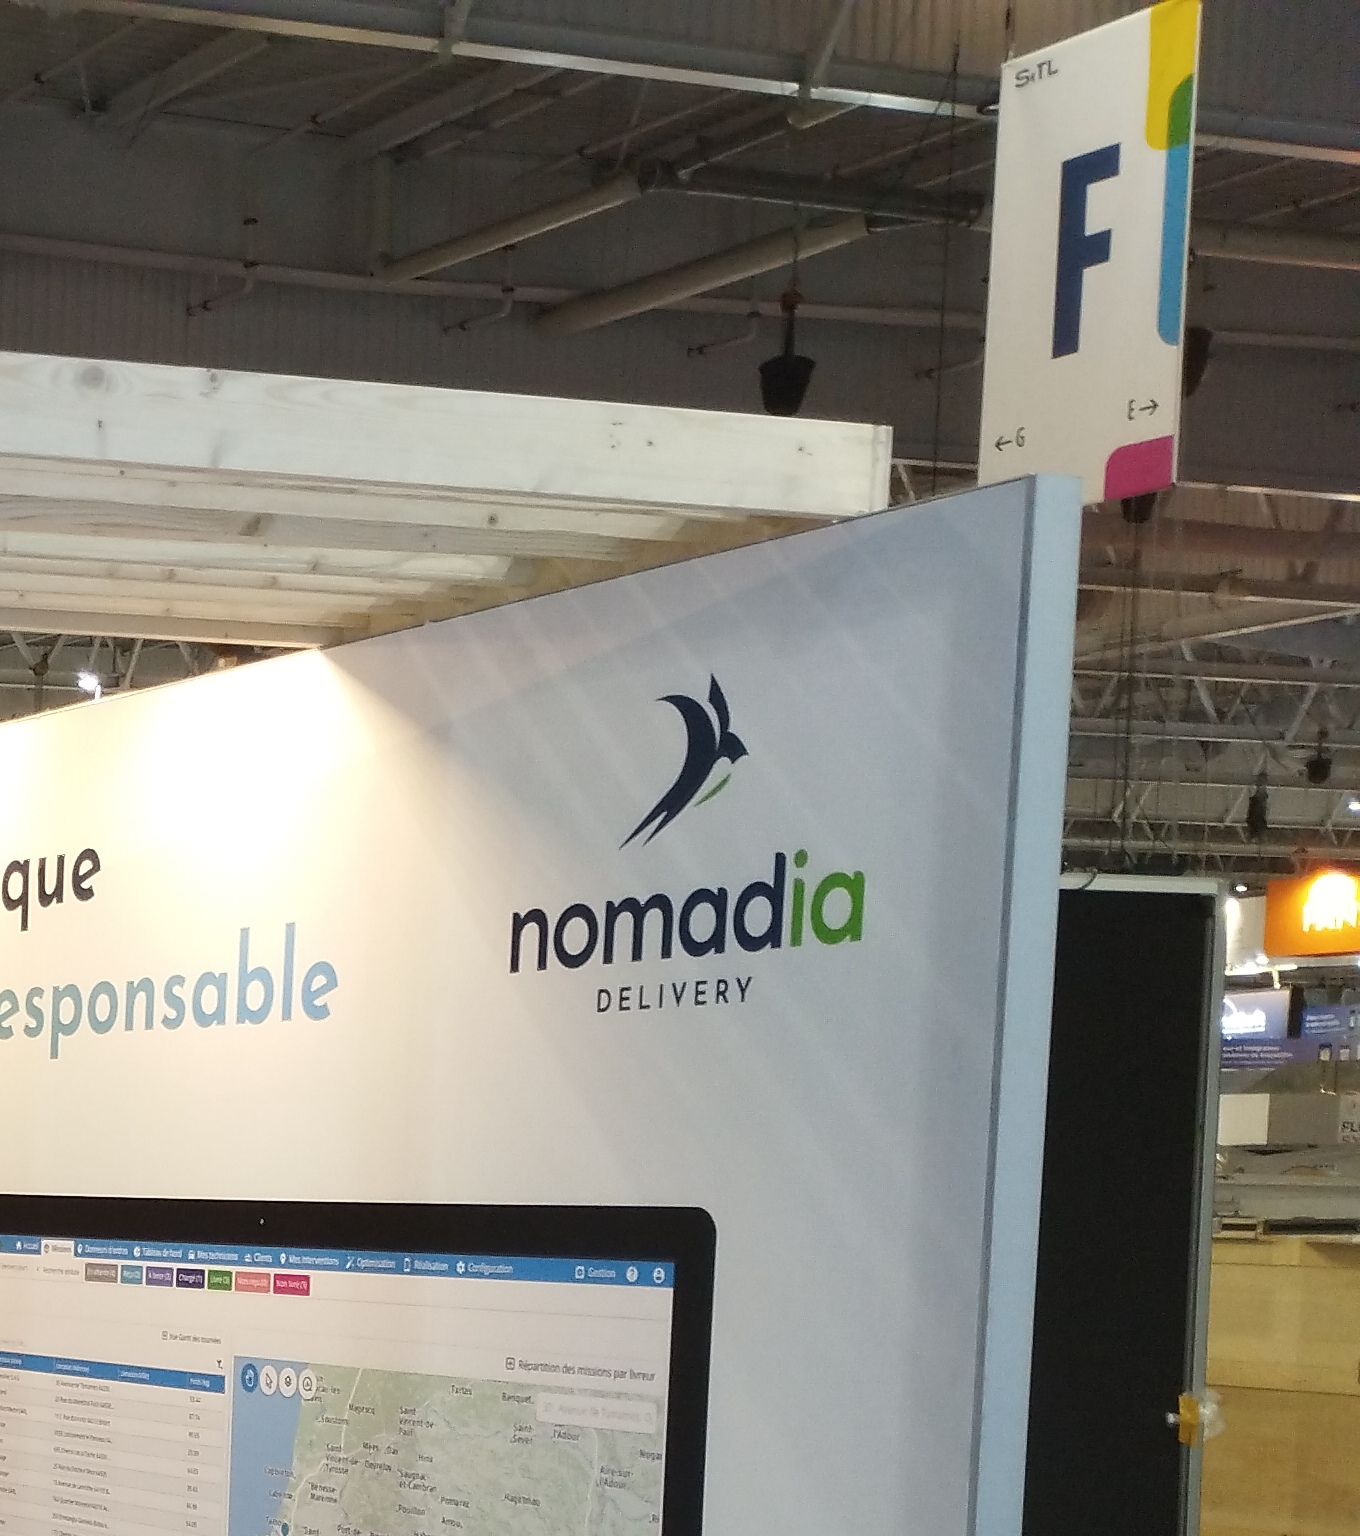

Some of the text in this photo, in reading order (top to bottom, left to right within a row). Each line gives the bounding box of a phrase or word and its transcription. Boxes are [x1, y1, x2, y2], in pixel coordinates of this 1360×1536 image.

[1052, 142, 1122, 359] F
[509, 849, 865, 974] nomadia
[596, 976, 753, 1013] DELIVERY
[562, 1364, 575, 1375] des
[614, 1369, 627, 1381] par
